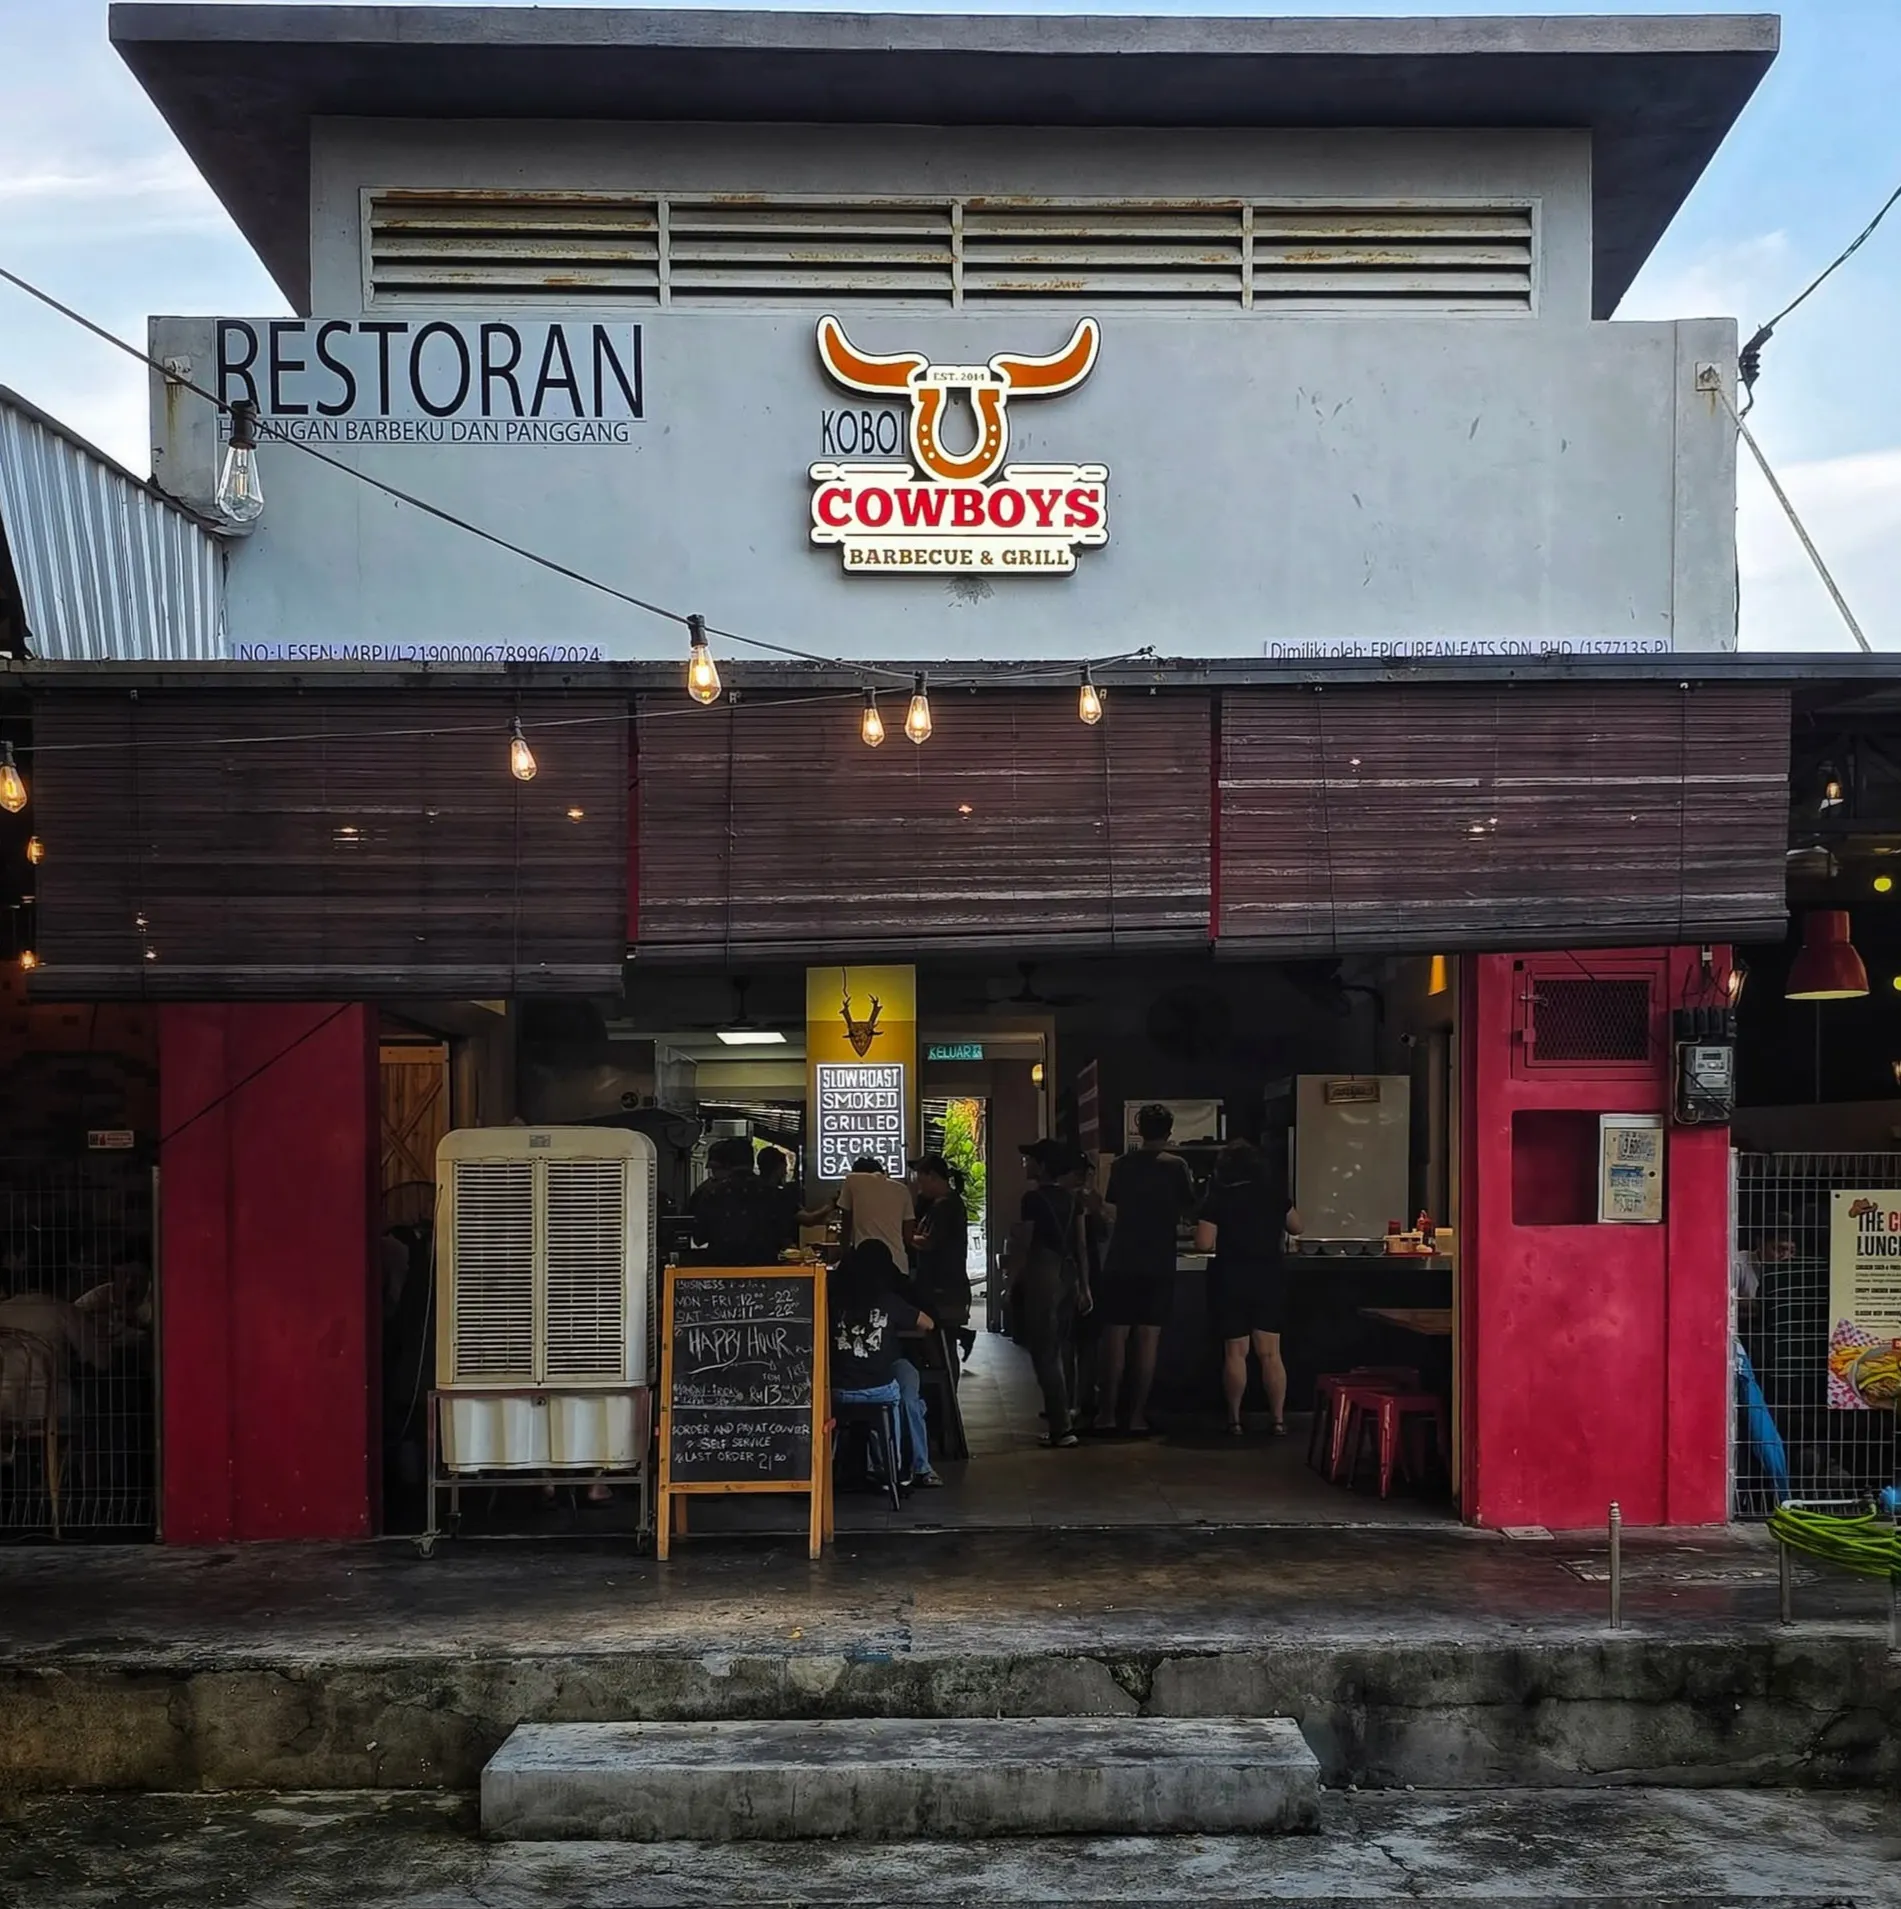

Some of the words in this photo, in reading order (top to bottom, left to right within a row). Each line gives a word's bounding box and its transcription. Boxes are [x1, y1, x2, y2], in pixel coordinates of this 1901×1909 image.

[216, 319, 643, 418] RESTORAN
[932, 371, 958, 381] EST.
[961, 371, 985, 381] 2014
[345, 421, 444, 441] BARBEKU
[451, 421, 498, 441] DAN
[506, 422, 629, 442] PANGGANG
[821, 409, 906, 455] KOBOI
[817, 487, 1100, 528] COWBOYS
[849, 549, 973, 566] BARBECUE
[981, 550, 994, 566] &
[1001, 549, 1070, 566] GRILL
[1271, 641, 1327, 659] Dimiliki
[929, 1044, 972, 1060] KELUAR
[822, 1068, 858, 1088] SLOW
[860, 1068, 900, 1088] ROAST
[821, 1091, 898, 1109] SMOKED
[823, 1114, 899, 1131] GRILLED
[822, 1136, 900, 1156] SECRET
[1857, 1211, 1885, 1233] THE
[1856, 1235, 1901, 1257] LUNC
[711, 1294, 732, 1307] FRI
[675, 1310, 702, 1323] SAT
[688, 1327, 740, 1366] HAPPY
[747, 1325, 795, 1359] HOUR
[713, 1422, 734, 1434] AND
[755, 1422, 769, 1433] AT
[700, 1437, 726, 1450] SELF
[732, 1436, 771, 1448] SERVICE
[685, 1451, 712, 1463] LAST
[717, 1451, 754, 1462] ORDER
